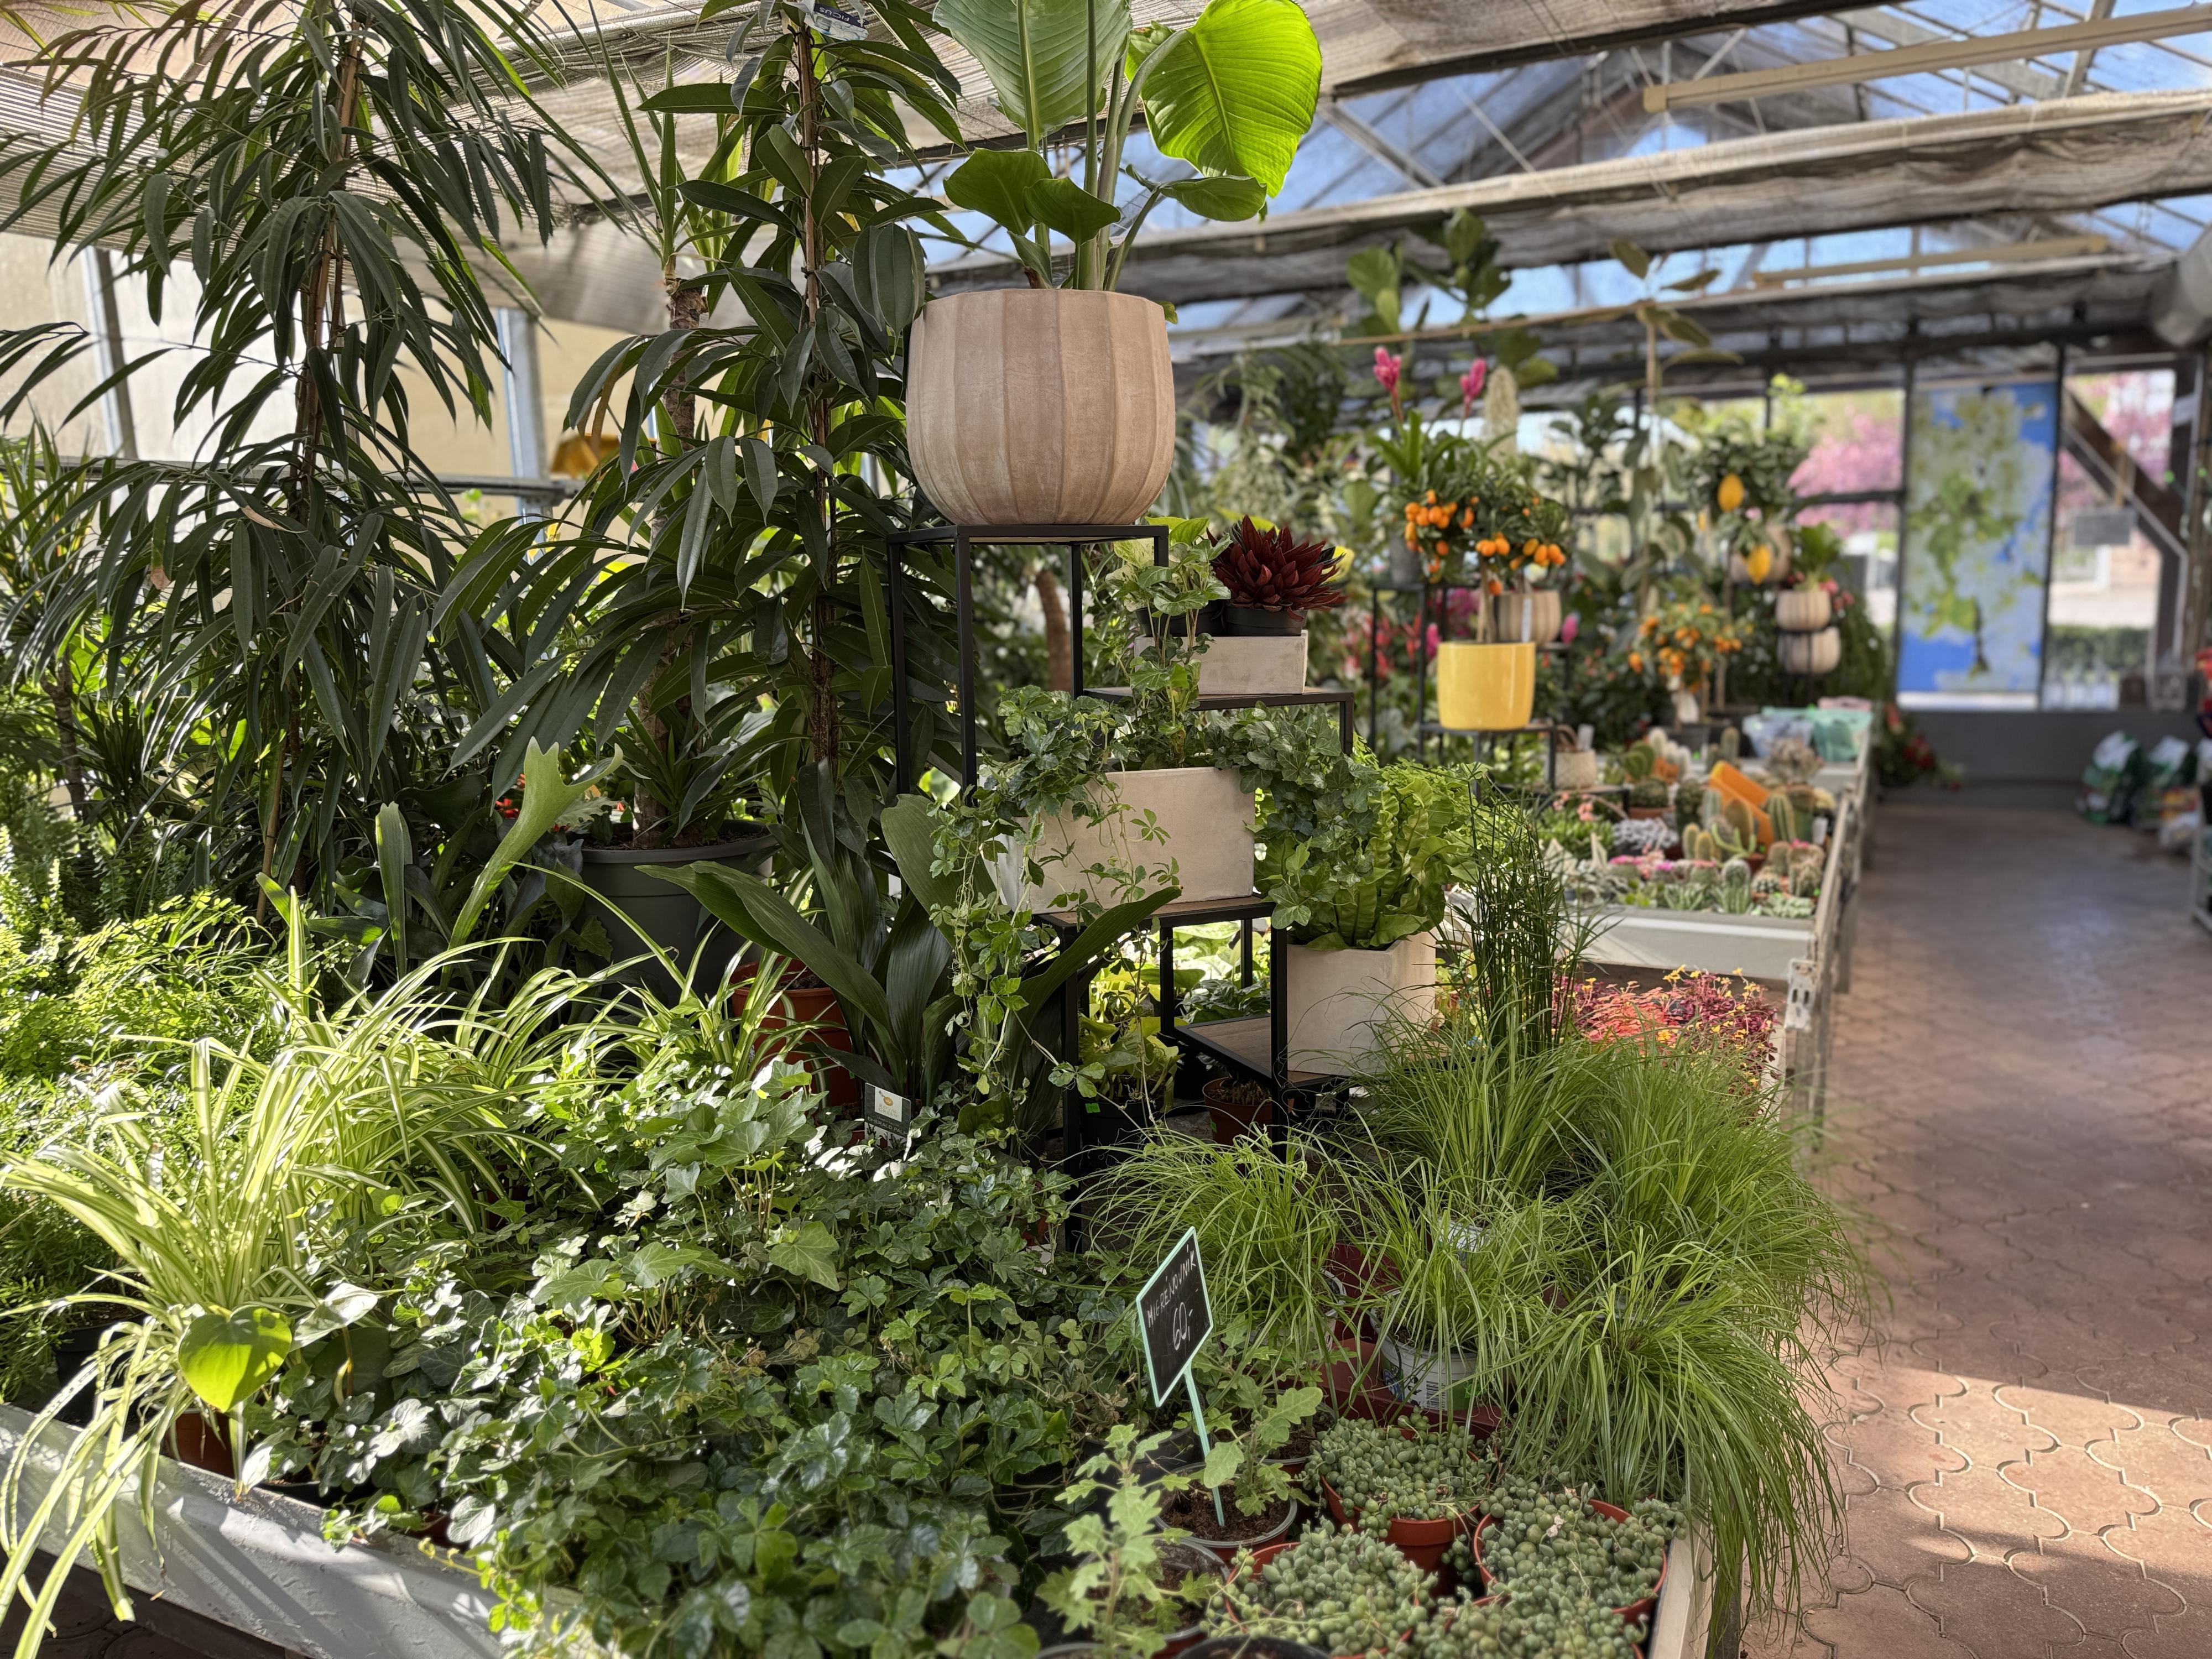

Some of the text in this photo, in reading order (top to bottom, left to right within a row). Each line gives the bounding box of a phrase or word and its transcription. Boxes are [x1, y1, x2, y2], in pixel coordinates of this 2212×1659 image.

[820, 7, 850, 22] FICUS
[879, 1104, 897, 1113] ROYAL
[879, 1108, 898, 1118] GREEN
[868, 1117, 893, 1129] EMERALD
[1147, 1244, 1196, 1328] MIGRÉNOVNÍK
